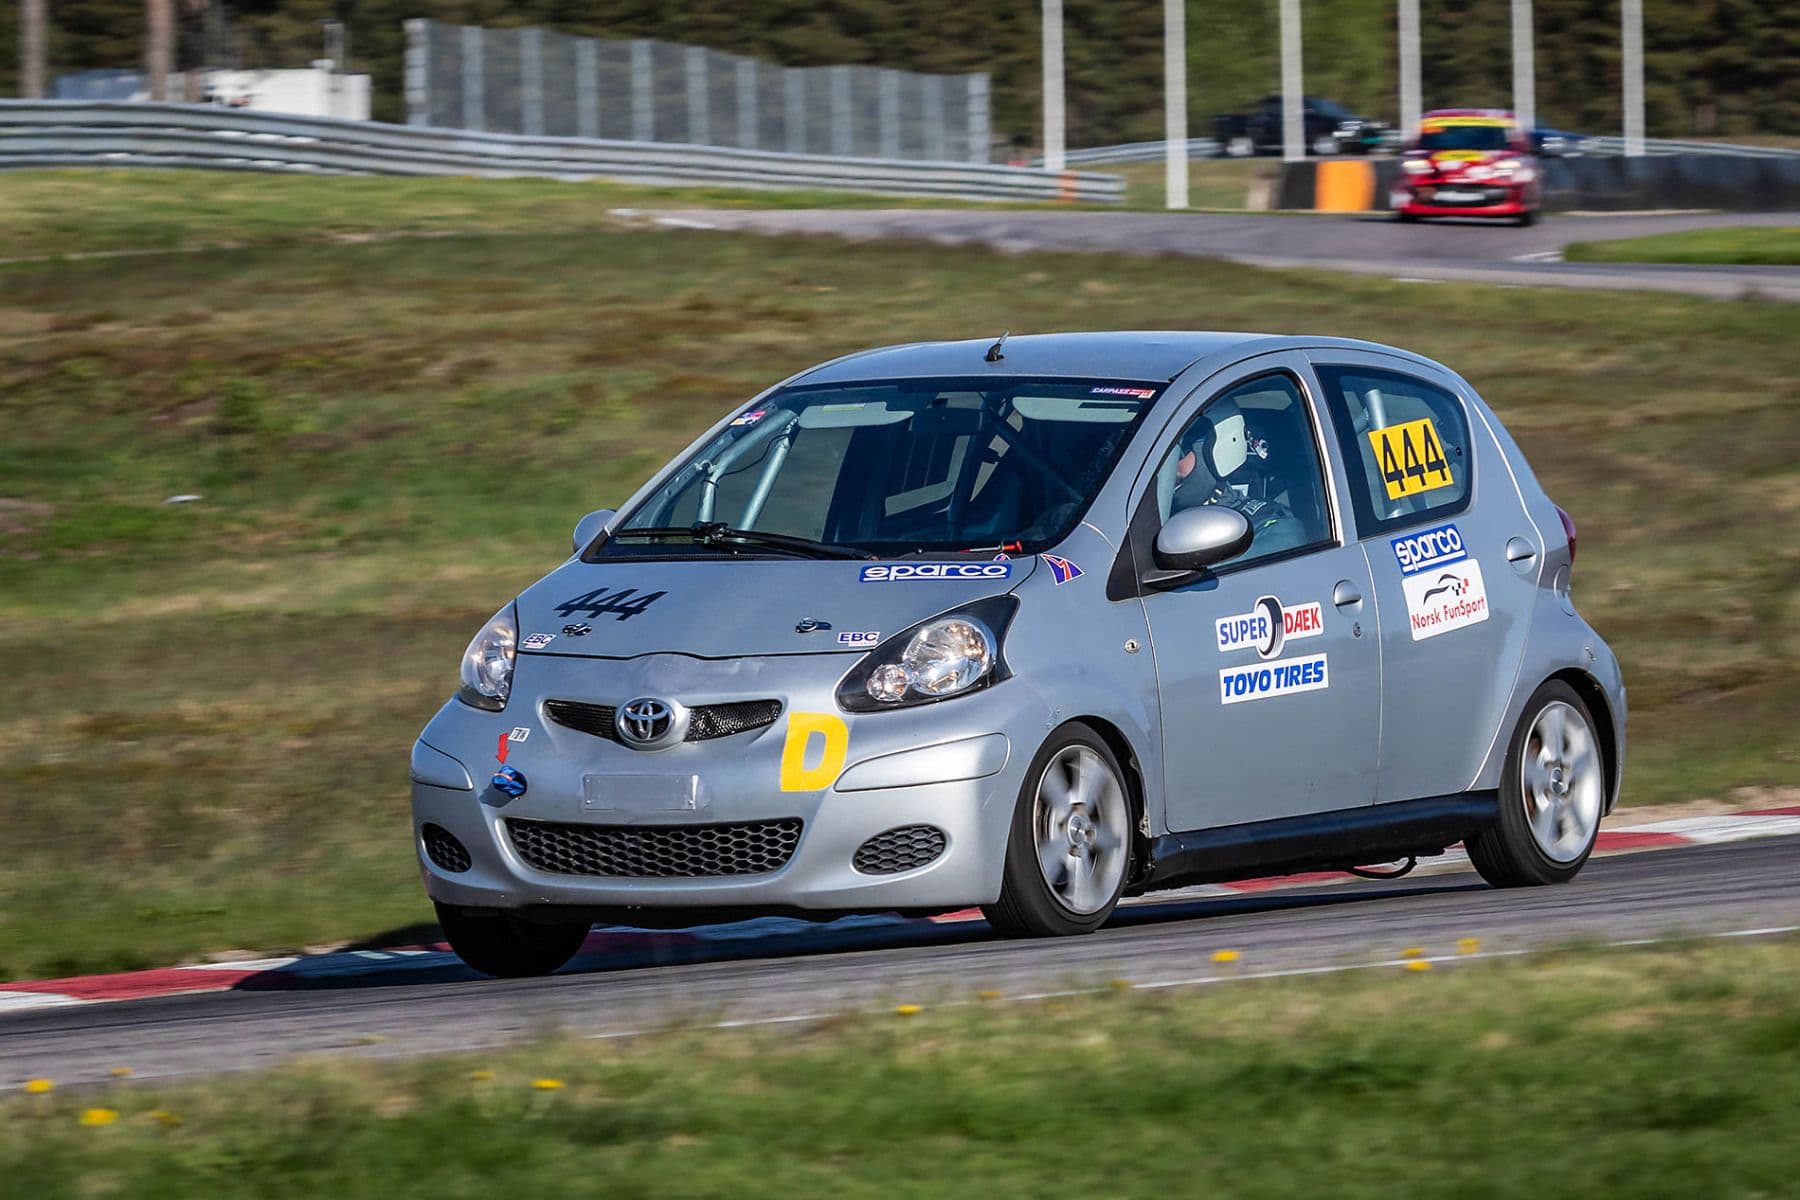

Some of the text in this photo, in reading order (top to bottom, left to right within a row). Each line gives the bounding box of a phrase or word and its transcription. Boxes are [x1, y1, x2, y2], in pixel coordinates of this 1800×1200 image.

[1382, 424, 1446, 492] 444
[1395, 528, 1462, 571] sparco
[864, 564, 1008, 581] sparco
[553, 587, 669, 621] 444
[1411, 596, 1486, 630] Norsk FunSport
[525, 634, 553, 644] EBC
[839, 632, 878, 642] EBC
[1220, 607, 1321, 645] SUPER DAEK
[1223, 660, 1325, 697] TOYO TIRES
[780, 711, 849, 793] D
